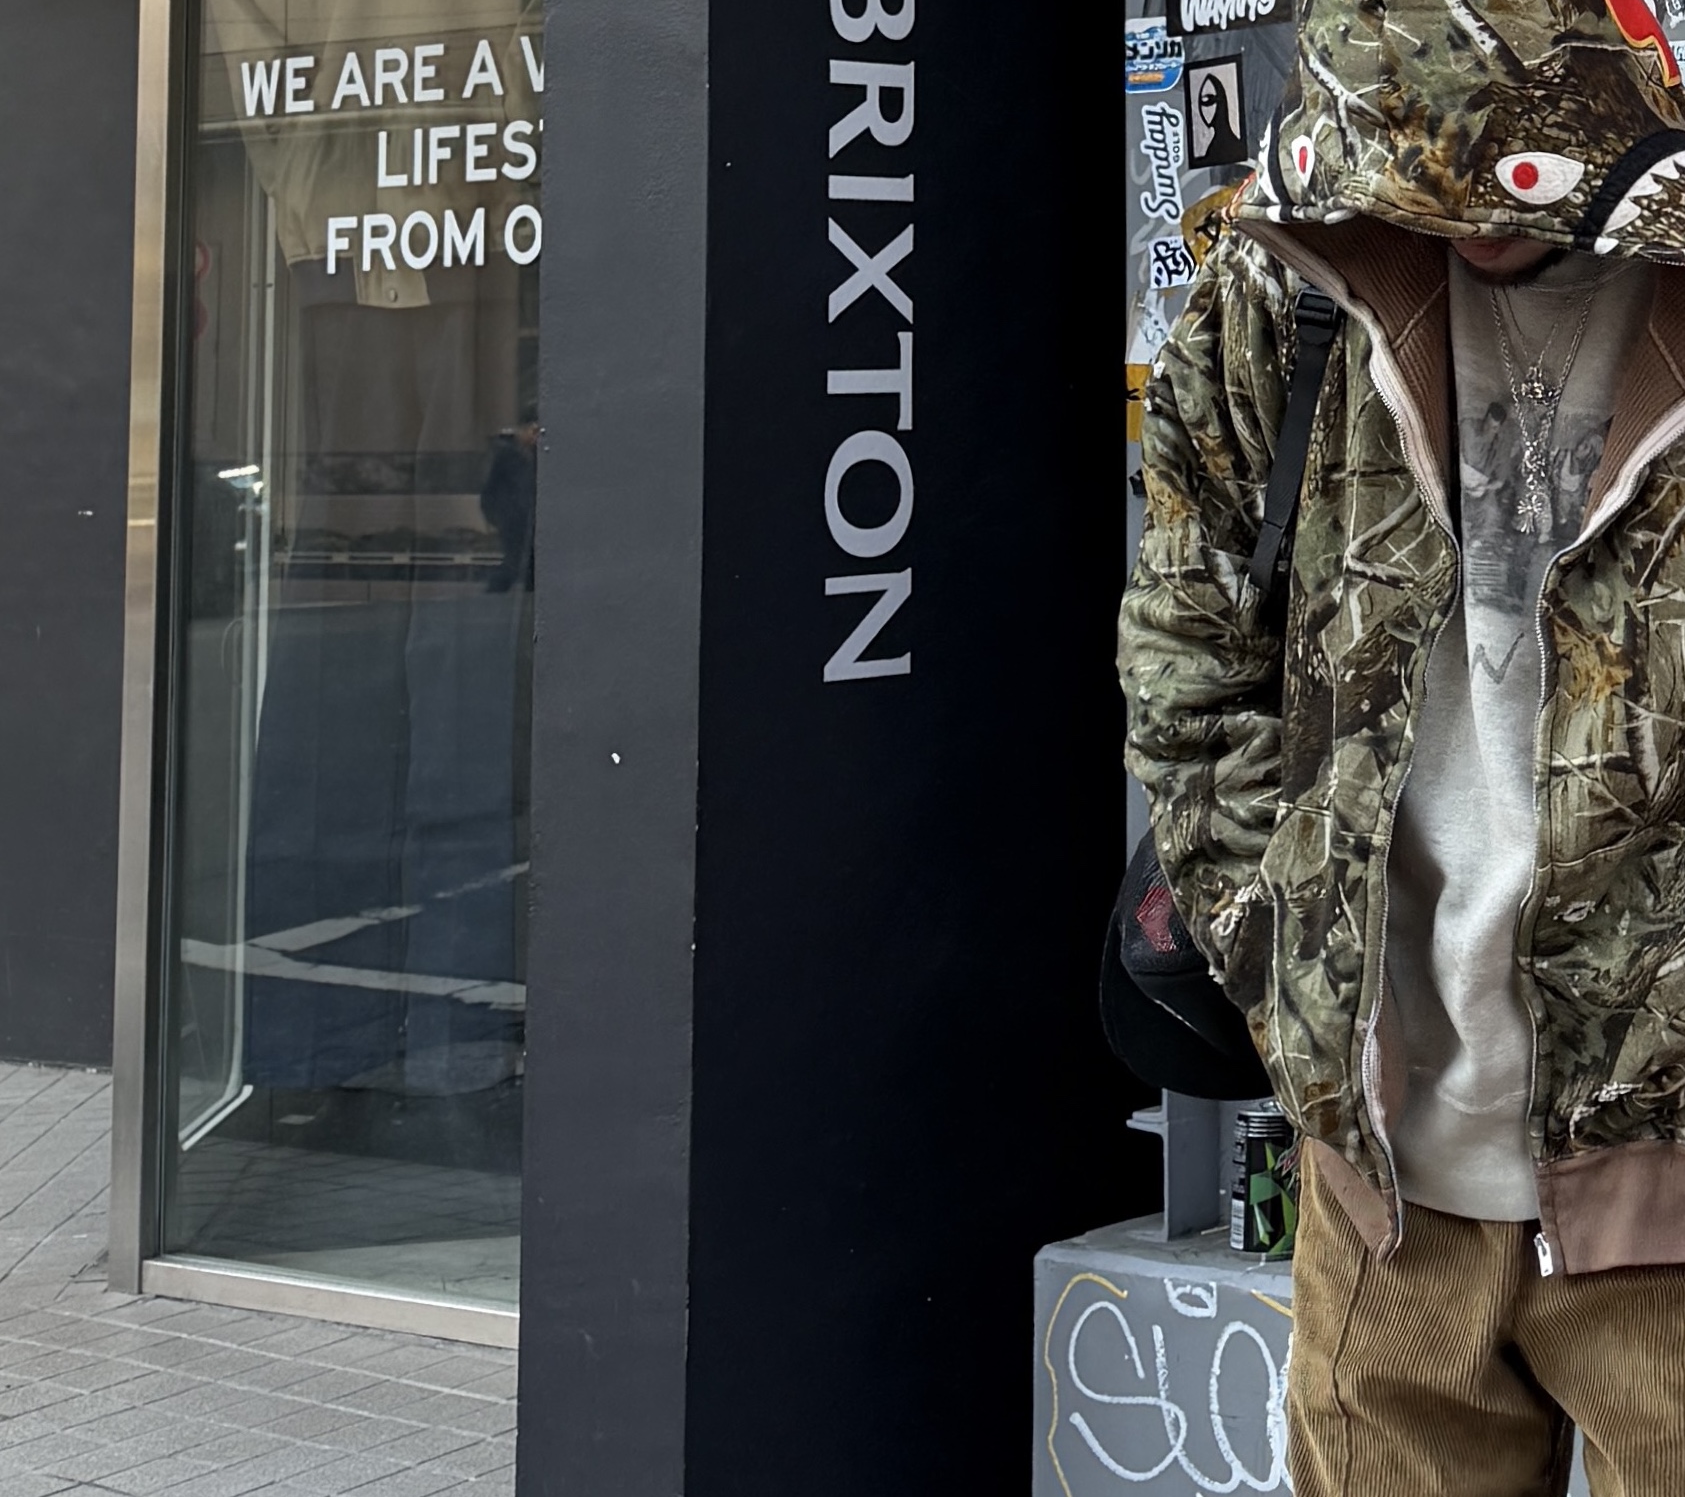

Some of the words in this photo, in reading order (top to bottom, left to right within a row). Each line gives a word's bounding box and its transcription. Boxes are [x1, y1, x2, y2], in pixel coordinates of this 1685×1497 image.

[242, 55, 315, 116] WE
[332, 43, 444, 107] ARE
[461, 39, 504, 98] A
[378, 120, 545, 189] LIFES
[1143, 106, 1180, 221] Sunday
[1173, 133, 1181, 162] GOLF
[328, 209, 487, 274] FROM
